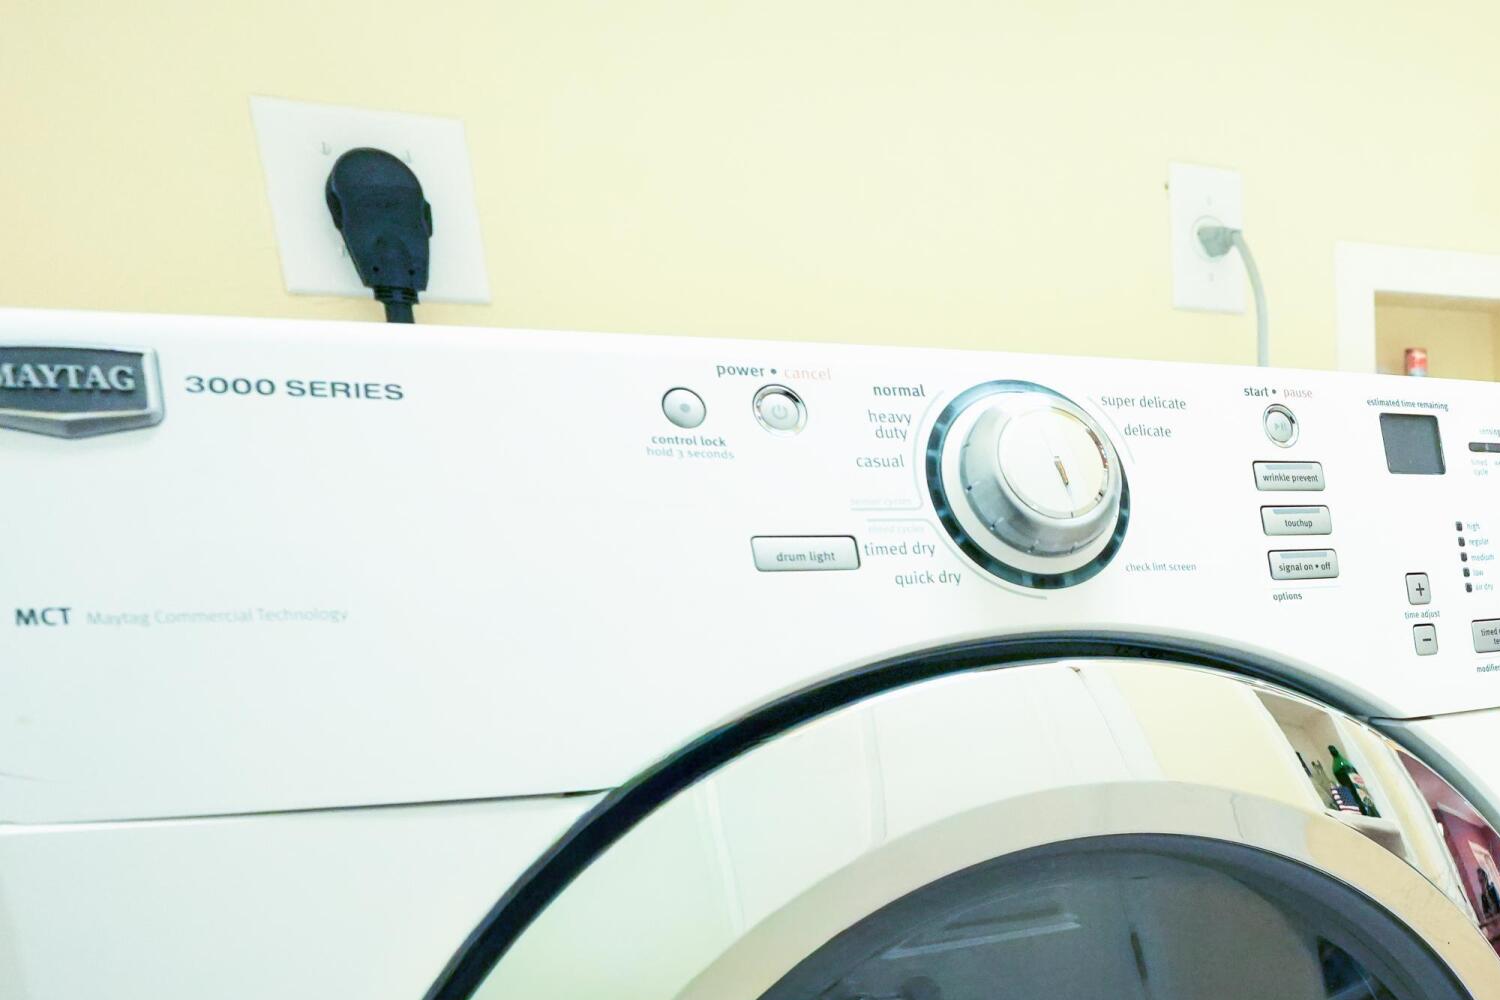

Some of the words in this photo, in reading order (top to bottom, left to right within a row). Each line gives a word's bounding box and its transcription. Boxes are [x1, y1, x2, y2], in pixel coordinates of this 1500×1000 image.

[716, 365, 765, 378] power
[784, 368, 832, 380] cancel
[185, 376, 276, 396] 3000
[286, 380, 404, 400] SERIES
[873, 384, 926, 398] normal
[1244, 386, 1269, 398] start
[1283, 388, 1313, 400] pause
[1101, 395, 1135, 408] super
[1139, 396, 1186, 410] delicate
[1366, 397, 1400, 408] estimated
[1400, 398, 1416, 408] time
[1416, 400, 1448, 412] remaining
[868, 410, 912, 425] heavy
[875, 426, 908, 442] duty
[1124, 424, 1172, 438] delicate
[651, 435, 696, 446] control
[700, 436, 726, 448] lock
[646, 446, 674, 457] hold
[687, 449, 735, 460] seconds
[856, 454, 904, 468] casual
[1262, 473, 1290, 482] wrinkle
[1291, 474, 1319, 485] prevent
[1284, 518, 1312, 528] touchup
[776, 552, 806, 562] drum
[809, 551, 836, 564] light
[864, 543, 908, 556] timed
[912, 543, 936, 558] dry
[1125, 562, 1152, 572] check
[1152, 562, 1166, 572] lint
[1168, 563, 1197, 572] screen
[1278, 562, 1302, 573] signal
[1320, 561, 1331, 571] off
[894, 571, 934, 588] quick
[938, 570, 962, 586] dry
[1272, 592, 1303, 602] options
[14, 607, 72, 627] MCT
[86, 610, 150, 628] Maytag
[154, 609, 254, 624] Commercial
[258, 607, 348, 623] Technology
[1404, 610, 1420, 619] time
[1420, 609, 1440, 620] adjust
[1480, 628, 1498, 636] timed
